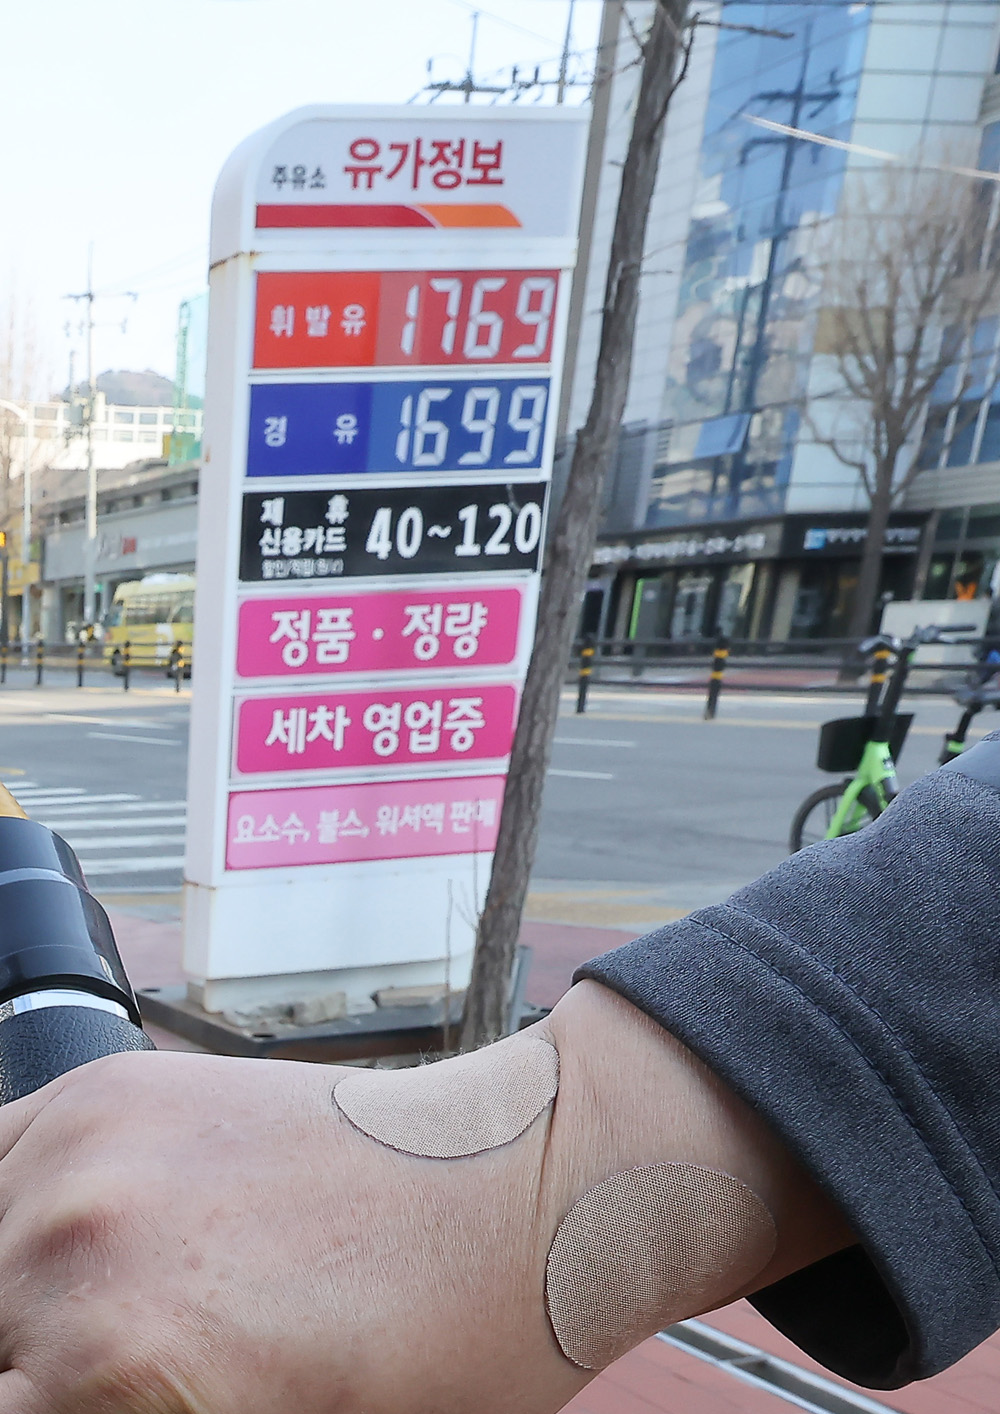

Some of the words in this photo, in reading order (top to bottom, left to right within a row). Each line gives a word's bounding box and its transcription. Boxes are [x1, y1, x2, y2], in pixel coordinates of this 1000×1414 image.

[272, 164, 326, 190] 주유소
[344, 138, 504, 190] 유가정보
[400, 277, 555, 360] 1769
[395, 386, 548, 467] 1699
[259, 525, 347, 556] 신용카드
[366, 502, 542, 561] 40~120
[269, 607, 355, 667] 정품
[402, 601, 488, 661] 정량
[265, 704, 351, 754] 세차
[362, 697, 486, 757] 영업중
[232, 815, 311, 845] 요소수,
